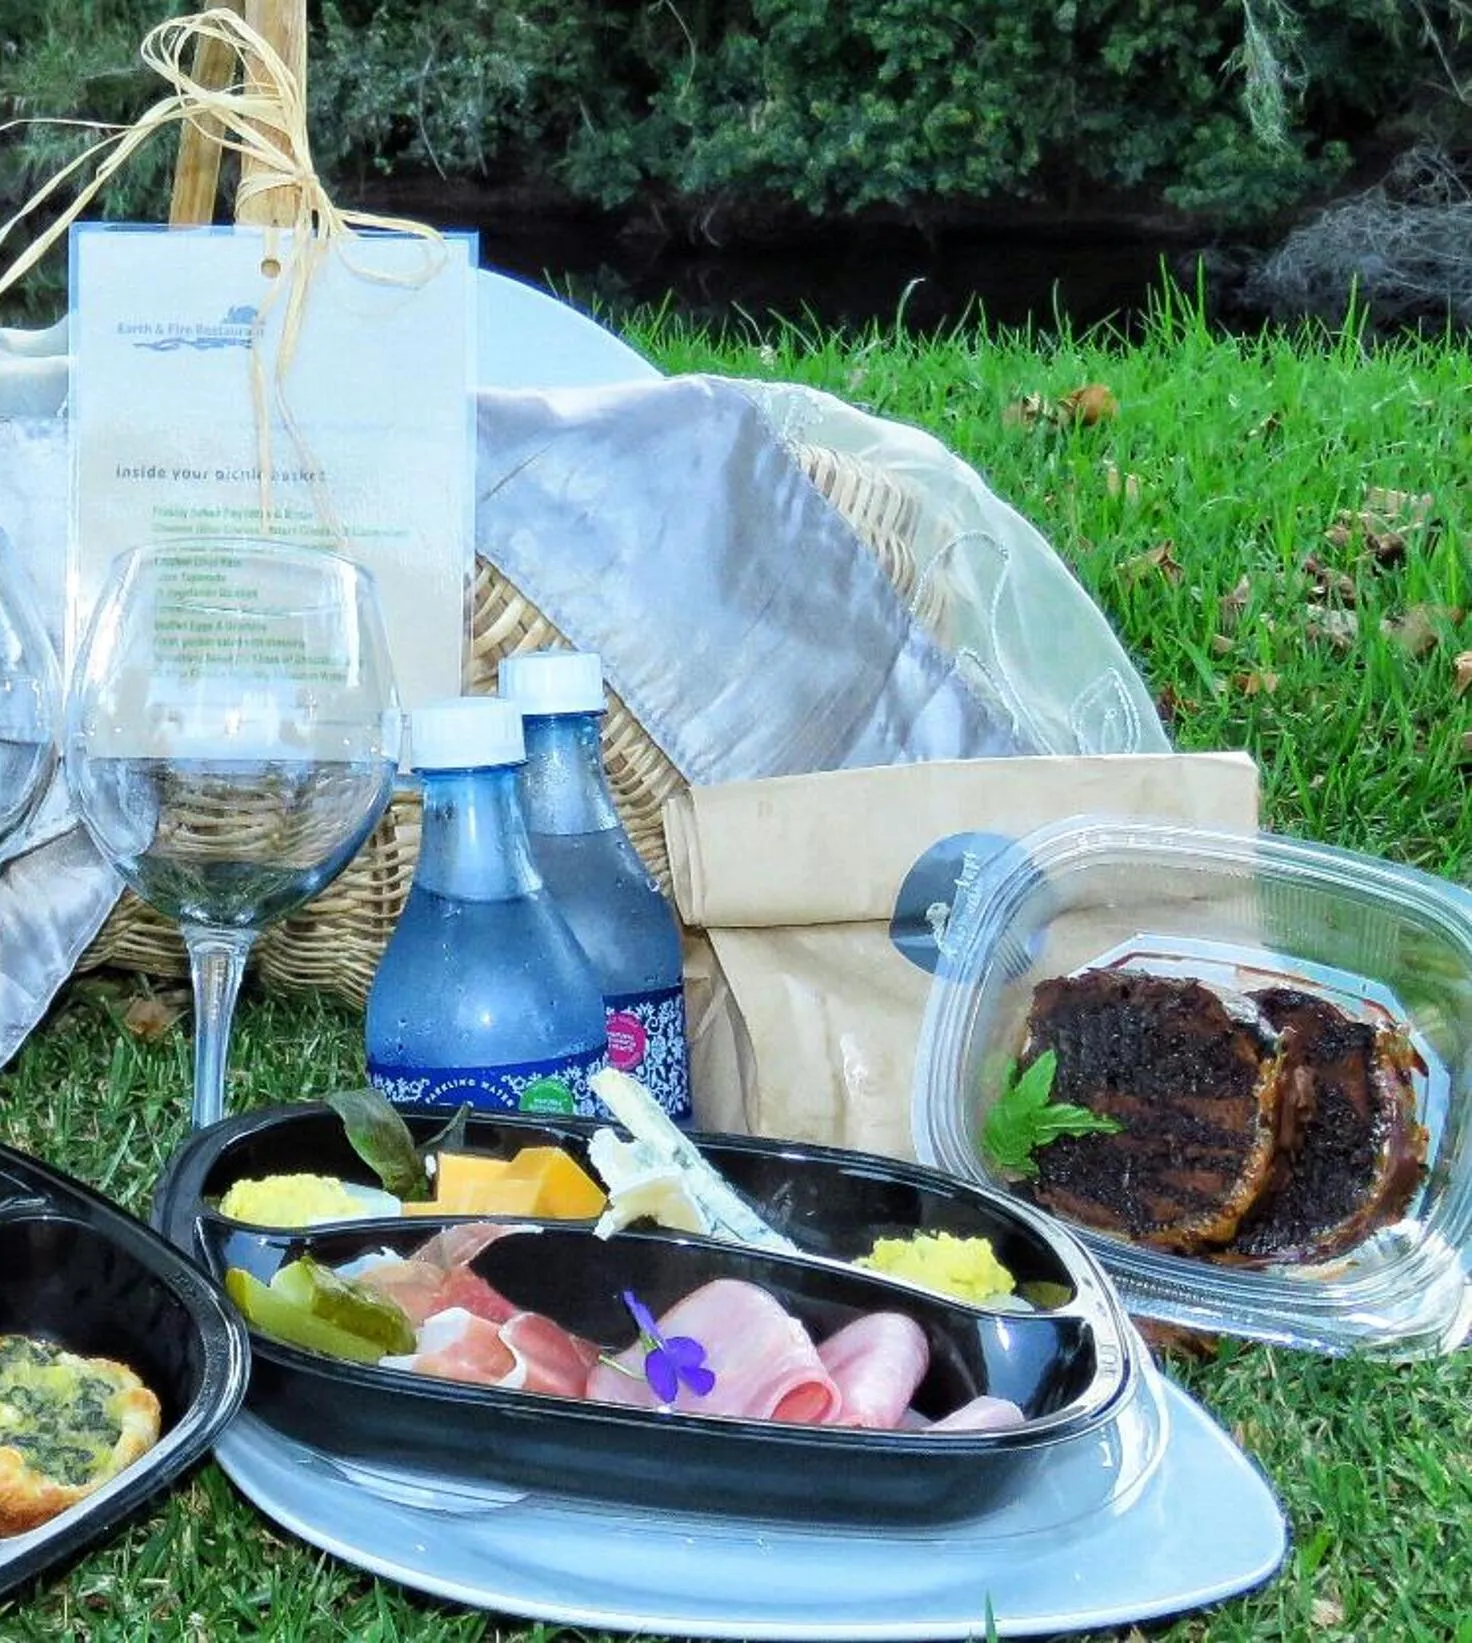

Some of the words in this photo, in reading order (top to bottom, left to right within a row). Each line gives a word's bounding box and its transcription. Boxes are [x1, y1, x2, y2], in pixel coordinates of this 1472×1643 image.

[117, 322, 153, 335] Earth
[155, 323, 164, 335] &
[171, 468, 208, 481] your
[424, 1078, 476, 1105] PARKLING
[480, 1080, 515, 1108] WATER
